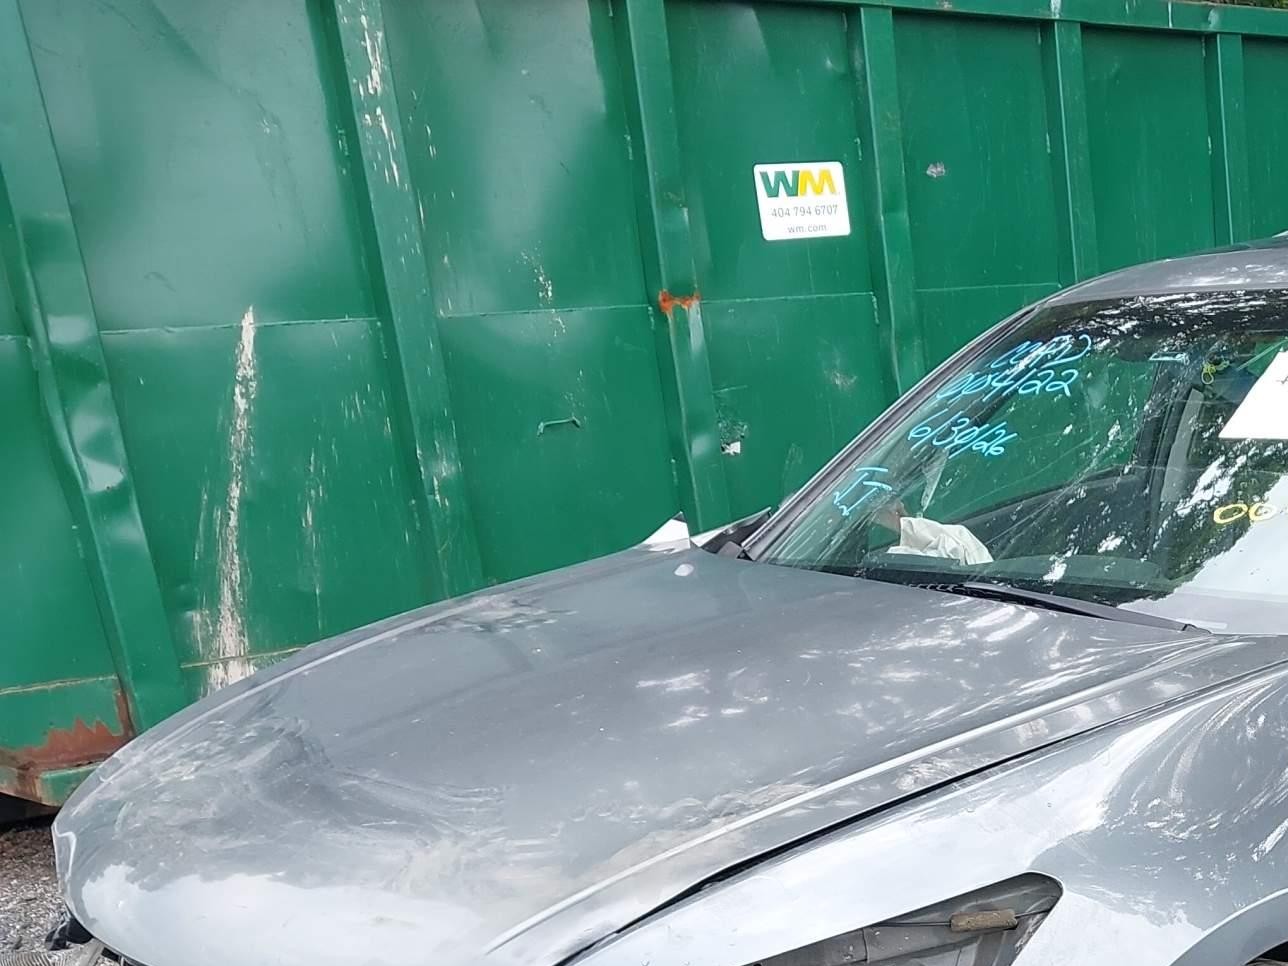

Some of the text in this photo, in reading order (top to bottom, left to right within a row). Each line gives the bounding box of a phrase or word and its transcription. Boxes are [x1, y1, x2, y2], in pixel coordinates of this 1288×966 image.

[760, 169, 837, 197] WM
[772, 204, 838, 217] 404 794 6707
[787, 224, 827, 233] wm.com
